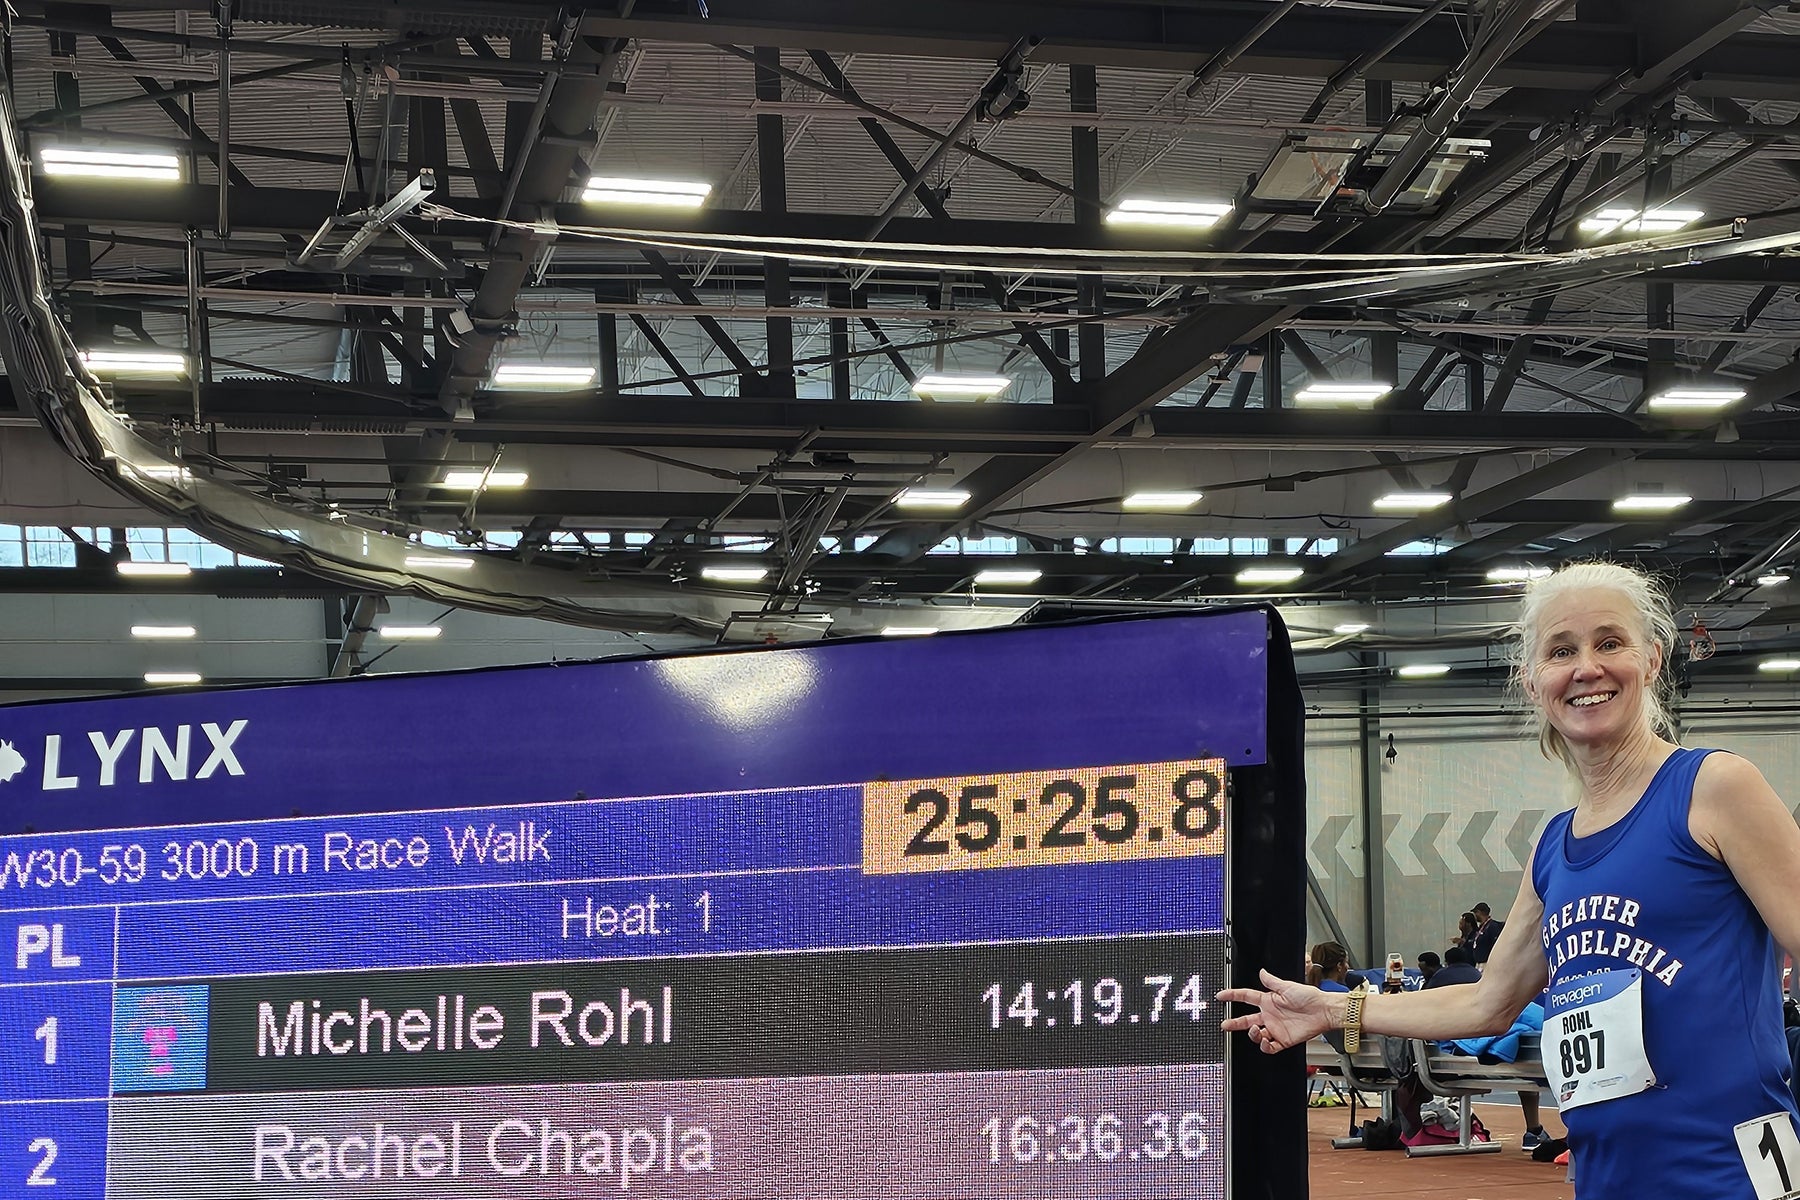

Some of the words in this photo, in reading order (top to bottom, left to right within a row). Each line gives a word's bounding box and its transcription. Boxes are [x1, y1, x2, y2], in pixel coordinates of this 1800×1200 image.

[42, 719, 249, 790] LYNX
[903, 770, 1221, 858] 25:25.8
[162, 838, 259, 881] 3000
[273, 844, 308, 875] m
[324, 832, 430, 872] Race
[446, 821, 552, 864] Walk
[561, 894, 672, 939] Heat:
[695, 890, 710, 932] 1
[1542, 895, 1640, 949] GREATER
[16, 924, 81, 969] PL
[1548, 930, 1683, 987] LADELPHIA
[35, 1016, 57, 1064] 1
[257, 996, 504, 1057] Michelle
[531, 986, 672, 1047] Rohl
[981, 975, 1206, 1028] 14:19.74
[1551, 983, 1601, 1009] Prevagen
[1562, 1010, 1593, 1035] ROHL
[1559, 1030, 1606, 1079] 897
[27, 1139, 58, 1186] 2
[253, 1120, 462, 1182] Rachel
[487, 1116, 716, 1190] Chapla
[981, 1113, 1208, 1163] 16:36.36
[1758, 1122, 1792, 1193] 1
